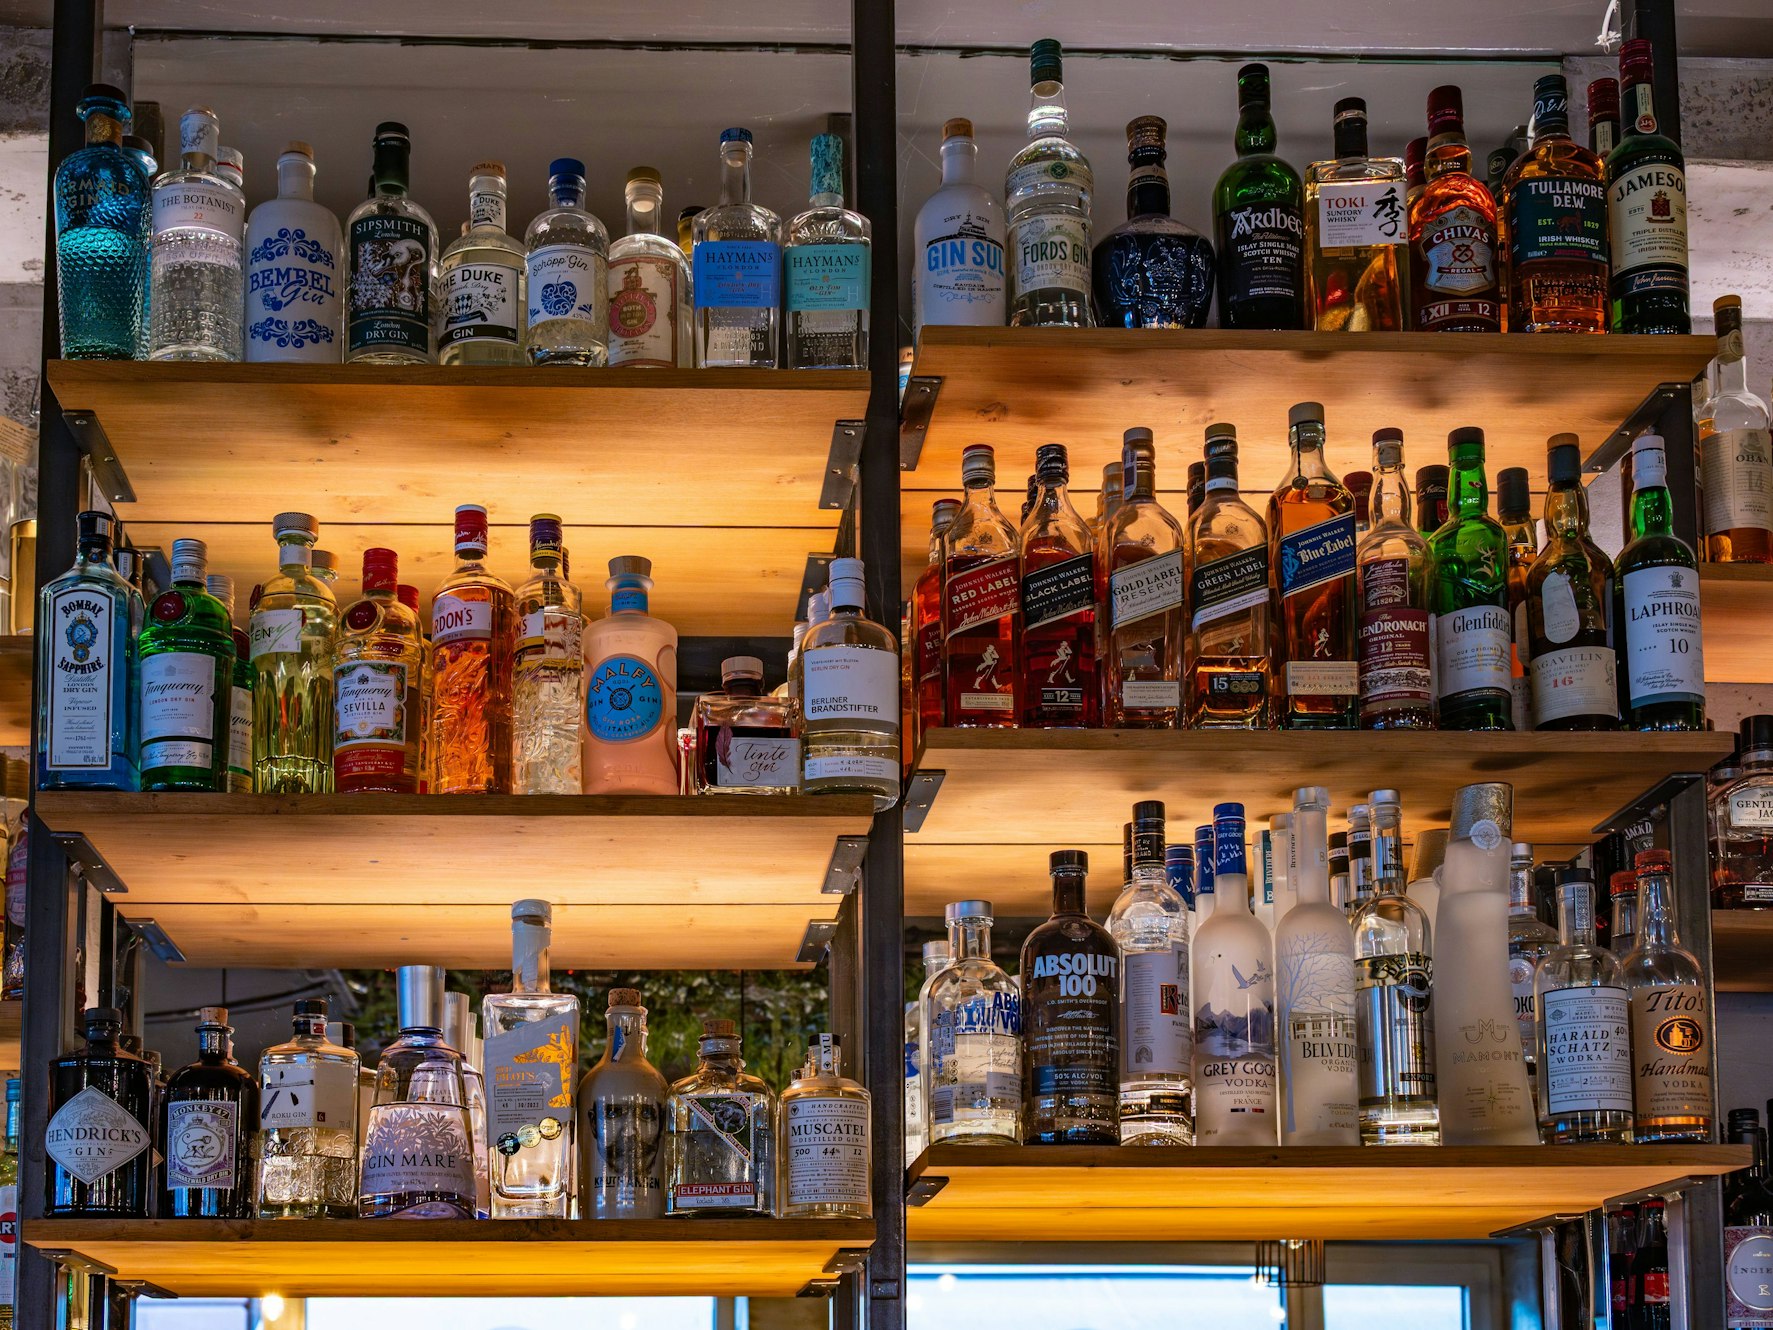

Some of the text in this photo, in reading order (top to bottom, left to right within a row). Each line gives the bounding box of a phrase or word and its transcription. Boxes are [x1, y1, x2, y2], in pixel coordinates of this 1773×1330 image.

[1528, 181, 1604, 201] TULLAMORE
[1617, 171, 1685, 203] JAMESO
[161, 194, 236, 215] THE BOTANIST
[480, 197, 500, 207] DUKE
[1325, 197, 1365, 209] TOKI
[1552, 195, 1587, 209] D.E.W.
[194, 212, 203, 221] 22
[944, 215, 990, 224] DRY GIN
[1537, 218, 1600, 229] EST. 1829
[356, 220, 421, 235] SIPSMITH
[1632, 228, 1657, 237] TRIPLE
[374, 231, 401, 239] London
[1432, 226, 1489, 244] CHIVAS
[1565, 236, 1600, 246] WHISKEY
[1023, 241, 1088, 267] FORDS GIN
[1238, 241, 1285, 253] ISLAY SINGLE
[1243, 249, 1297, 258] SCOTCH WHISKY
[928, 240, 1004, 277] GIN SUL
[250, 267, 335, 297] BEMBEL
[438, 269, 504, 295] THE DUKE
[281, 279, 326, 308] Gin
[1478, 303, 1490, 316] 12
[374, 321, 400, 330] London
[366, 331, 409, 339] DRY GIN
[452, 328, 474, 340] GIN
[1736, 454, 1769, 464] OBAN
[1298, 527, 1345, 549] JOHNNIE WALKER
[1296, 535, 1355, 566] Blue Label
[1204, 557, 1253, 579] JOHNNIE WALKER
[955, 567, 1013, 593] JOHNNIE WALKER
[1029, 566, 1088, 592] JOHNNIE WALKER
[1114, 566, 1183, 596] GOLD LABEL
[1198, 561, 1266, 590] GREEN LABEL
[952, 576, 1018, 605] RED LABEL
[1025, 573, 1093, 603] BLACK LABEL
[1121, 577, 1181, 602] RESERVE
[61, 600, 104, 618] BOMBAY
[1631, 602, 1701, 622] LAPHROA
[433, 608, 473, 636] RDON'S
[1359, 621, 1426, 640] LENDRONACH
[1369, 634, 1405, 643] ORIGINAL
[1381, 641, 1393, 653] 12
[1669, 638, 1689, 654] 10
[58, 656, 105, 675] SAPPHIRE
[592, 663, 656, 693] MALFY
[1213, 677, 1229, 690] 15
[1552, 676, 1574, 689] 16
[145, 681, 204, 697] Tanqueray
[341, 687, 392, 700] Tanqueray
[1055, 690, 1070, 702] 12
[639, 696, 658, 704] GIN
[812, 697, 848, 706] BERLINER
[344, 702, 385, 714] SEVILLA
[812, 704, 878, 714] BRANDSTIFTER
[743, 762, 781, 781] gin
[1737, 800, 1773, 809] GENTL
[1034, 953, 1118, 979] ABSOLUT
[1058, 975, 1097, 997] 100
[1646, 988, 1705, 1013] Tito's
[1549, 1030, 1609, 1044] HARALD
[1550, 1042, 1610, 1056] SCHATZ
[1452, 1050, 1519, 1065] MAMONT
[1557, 1054, 1603, 1064] WODKA
[1204, 1062, 1276, 1078] GREY GOOS
[1641, 1058, 1710, 1078] Handma
[1225, 1079, 1268, 1089] VODKA
[1663, 1081, 1703, 1089] VODKA
[173, 1105, 228, 1119] MONKEY 47
[49, 1128, 141, 1144] HENDRICK'S
[791, 1123, 866, 1137] MUSCATEL
[76, 1147, 106, 1156] GIN
[795, 1148, 811, 1157] 500
[368, 1154, 456, 1170] GIN MARE
[681, 1185, 751, 1195] ELEPHANT GIN
